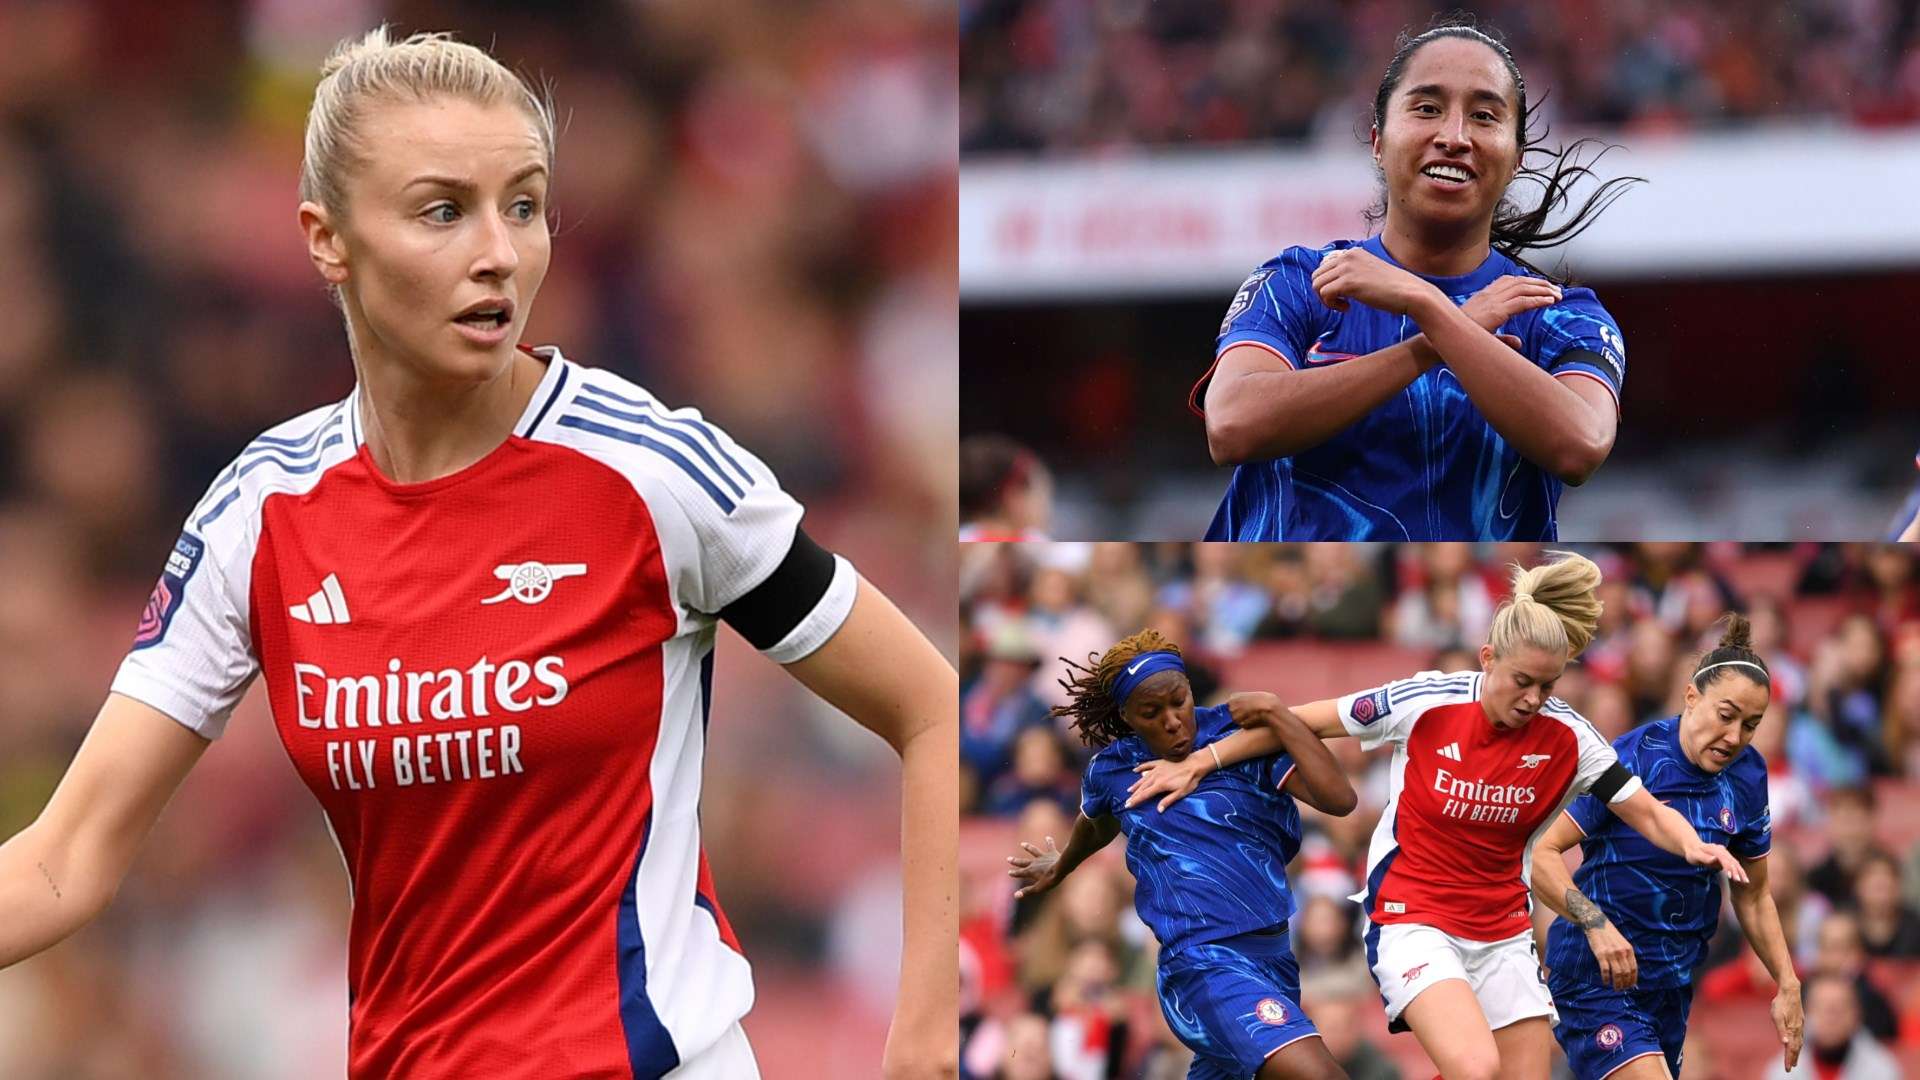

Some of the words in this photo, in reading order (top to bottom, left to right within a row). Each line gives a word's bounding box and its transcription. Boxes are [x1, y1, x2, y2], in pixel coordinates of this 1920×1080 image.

[294, 656, 569, 729] Emirates
[327, 739, 376, 790] FLY
[393, 725, 524, 787] BETTER
[1434, 768, 1536, 804] Emirates
[1442, 799, 1469, 819] FLY
[1470, 804, 1519, 824] BETTER
